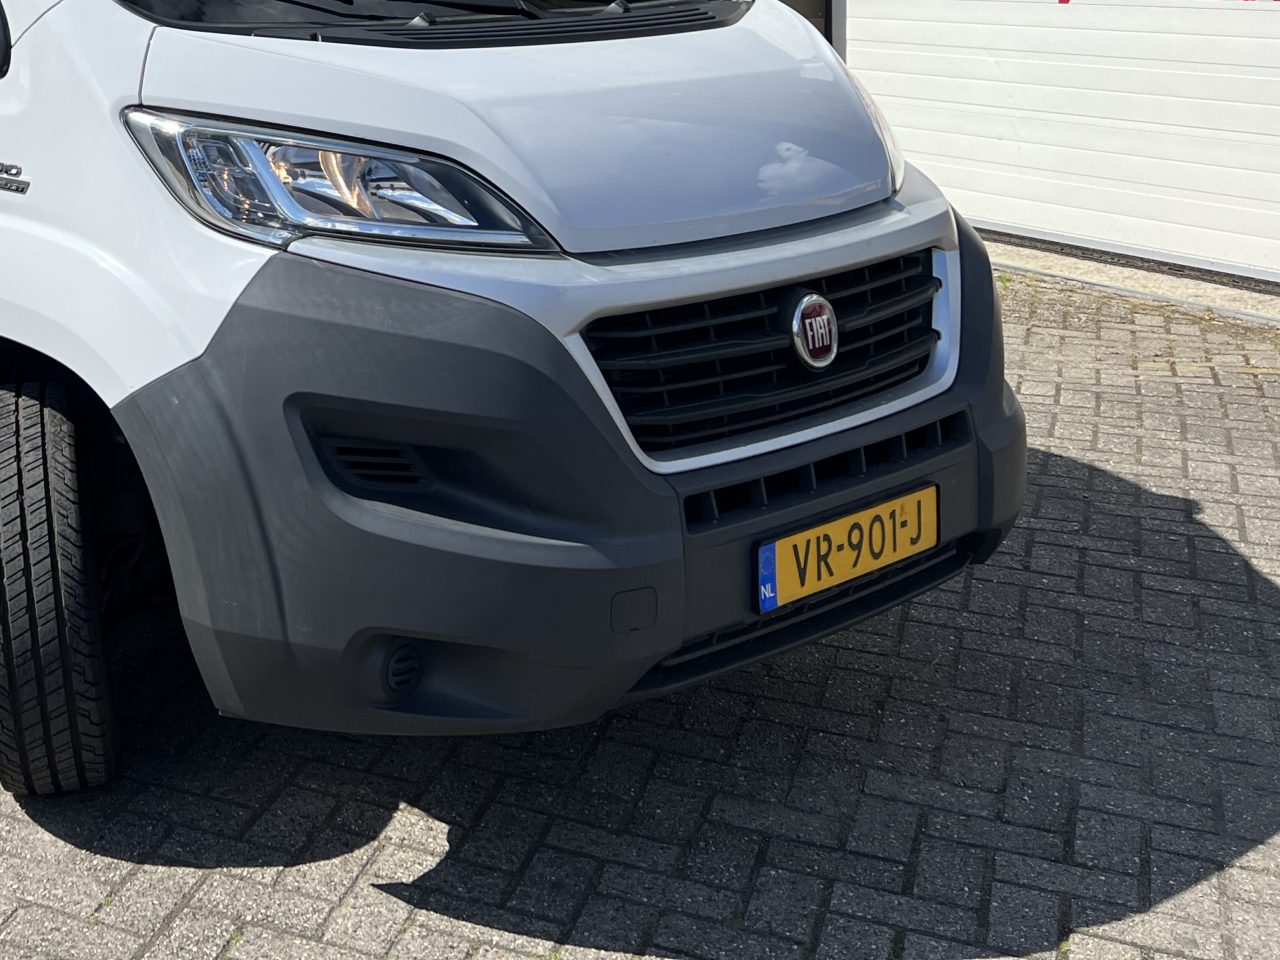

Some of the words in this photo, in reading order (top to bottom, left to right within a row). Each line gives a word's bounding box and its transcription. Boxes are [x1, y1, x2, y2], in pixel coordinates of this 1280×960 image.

[804, 314, 830, 350] FIAT
[792, 499, 922, 588] VR-901-J
[760, 582, 776, 600] NL
